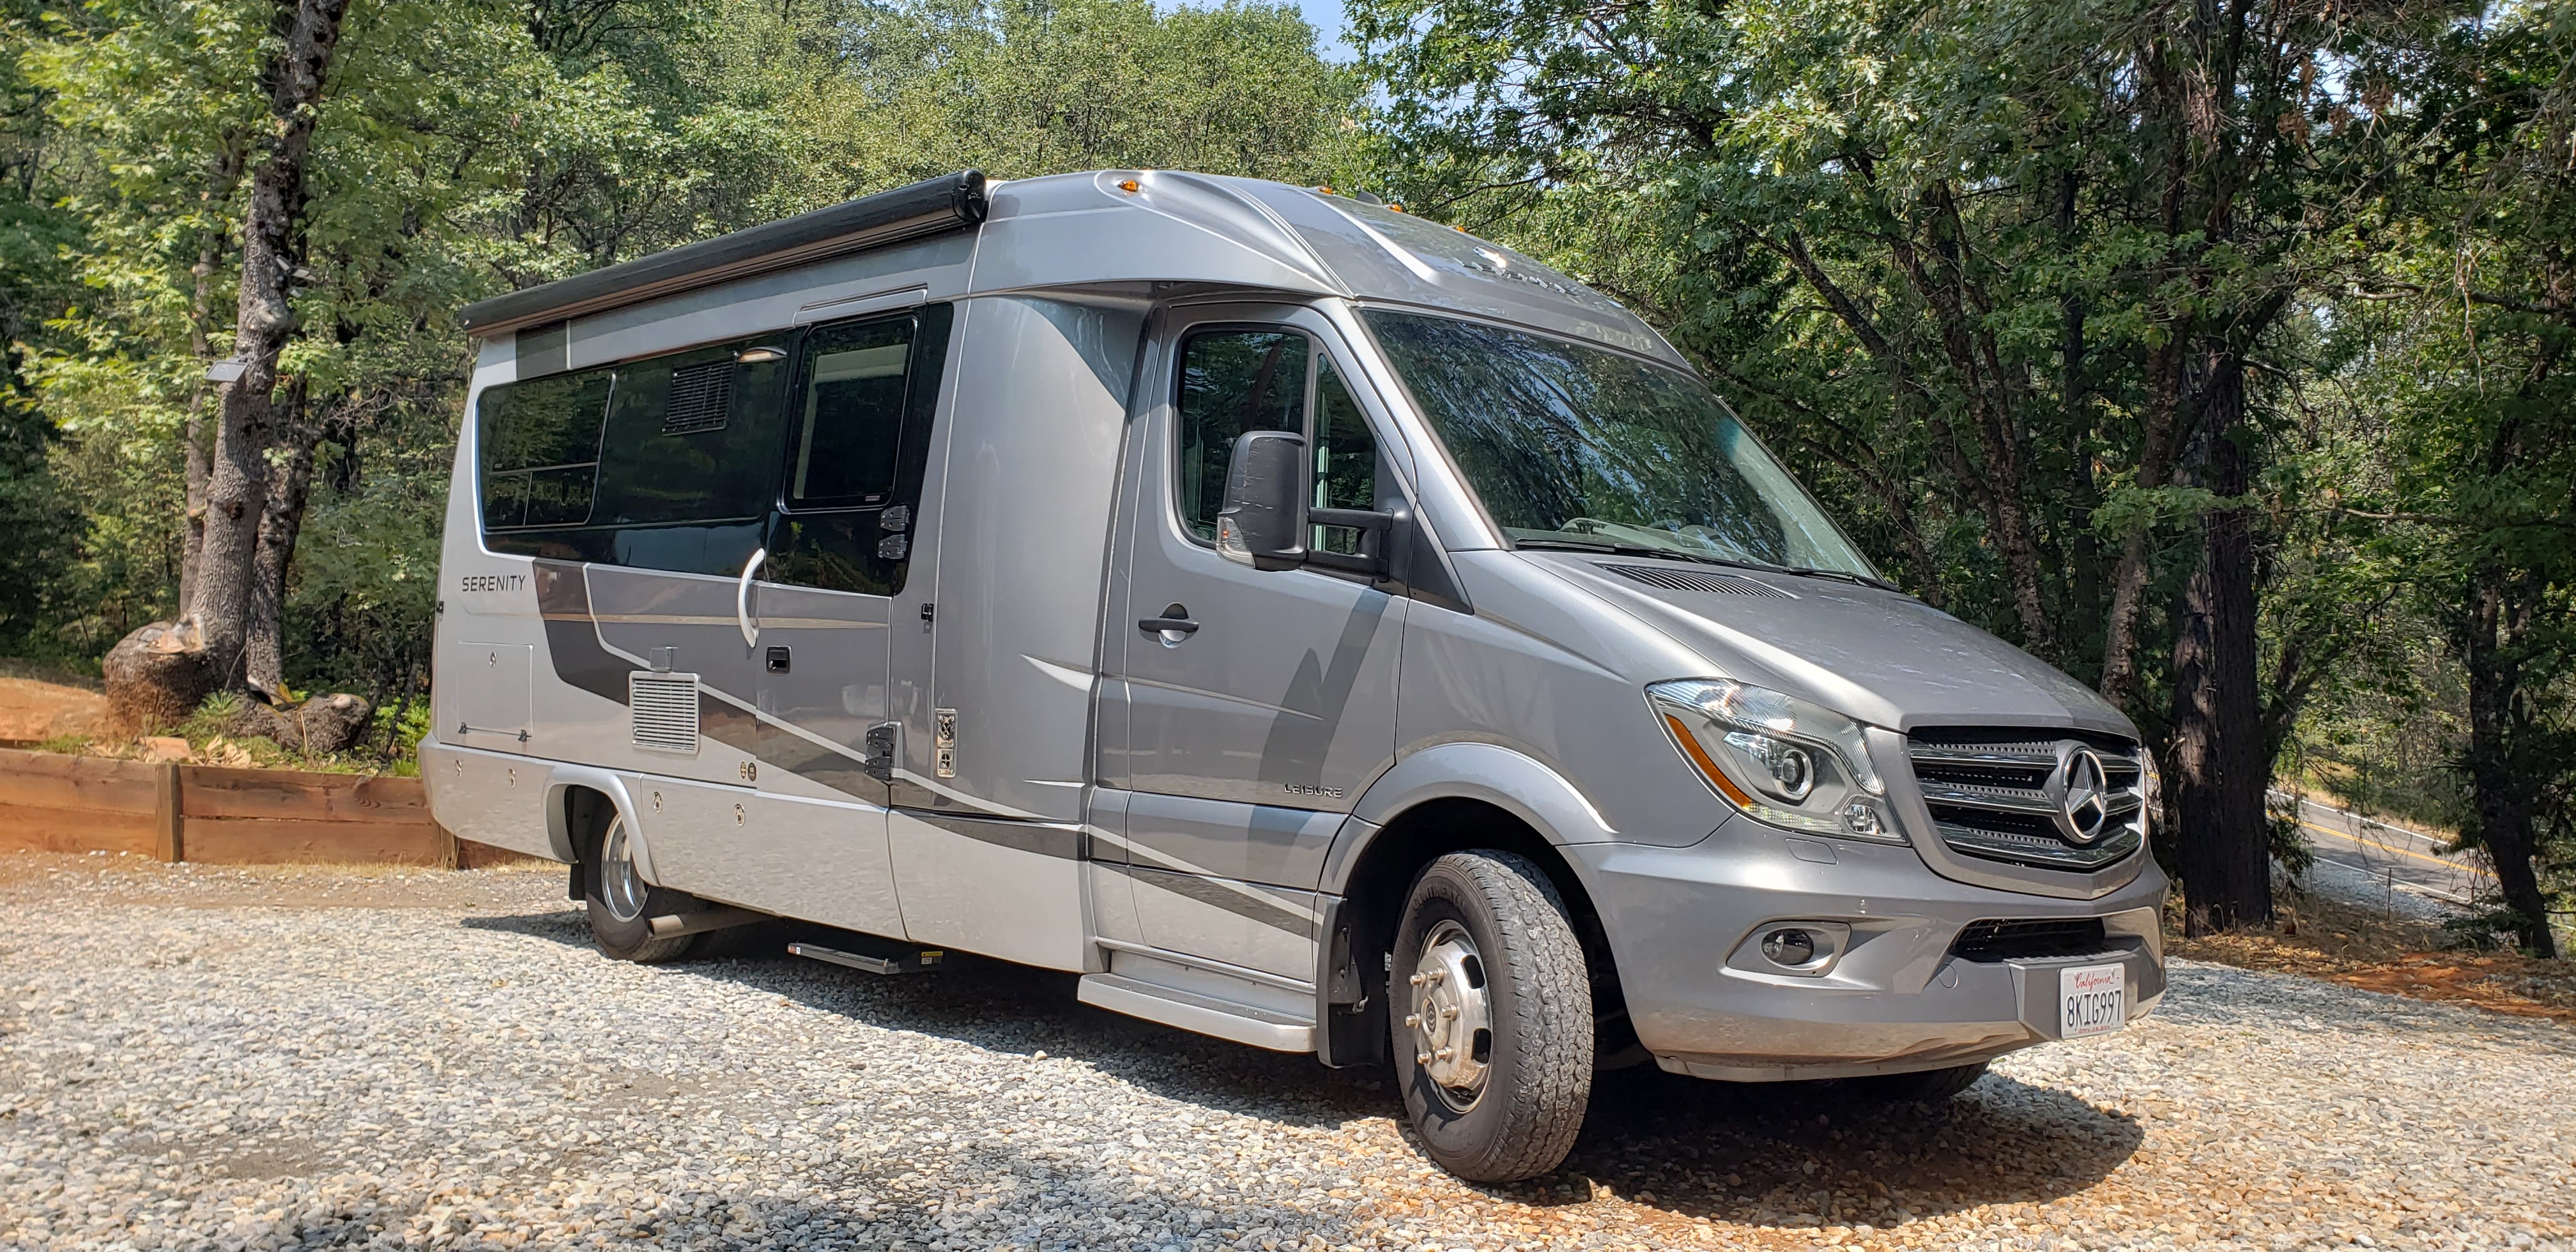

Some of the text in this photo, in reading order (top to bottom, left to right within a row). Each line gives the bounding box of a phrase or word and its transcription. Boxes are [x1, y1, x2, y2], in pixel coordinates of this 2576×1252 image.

[462, 575, 526, 592] SERENITY
[1284, 783, 1343, 798] LEISURE
[2075, 972, 2114, 991] California
[2067, 989, 2121, 1027] 8KIG997
[2078, 1025, 2111, 1034] dmv.ca.gov
